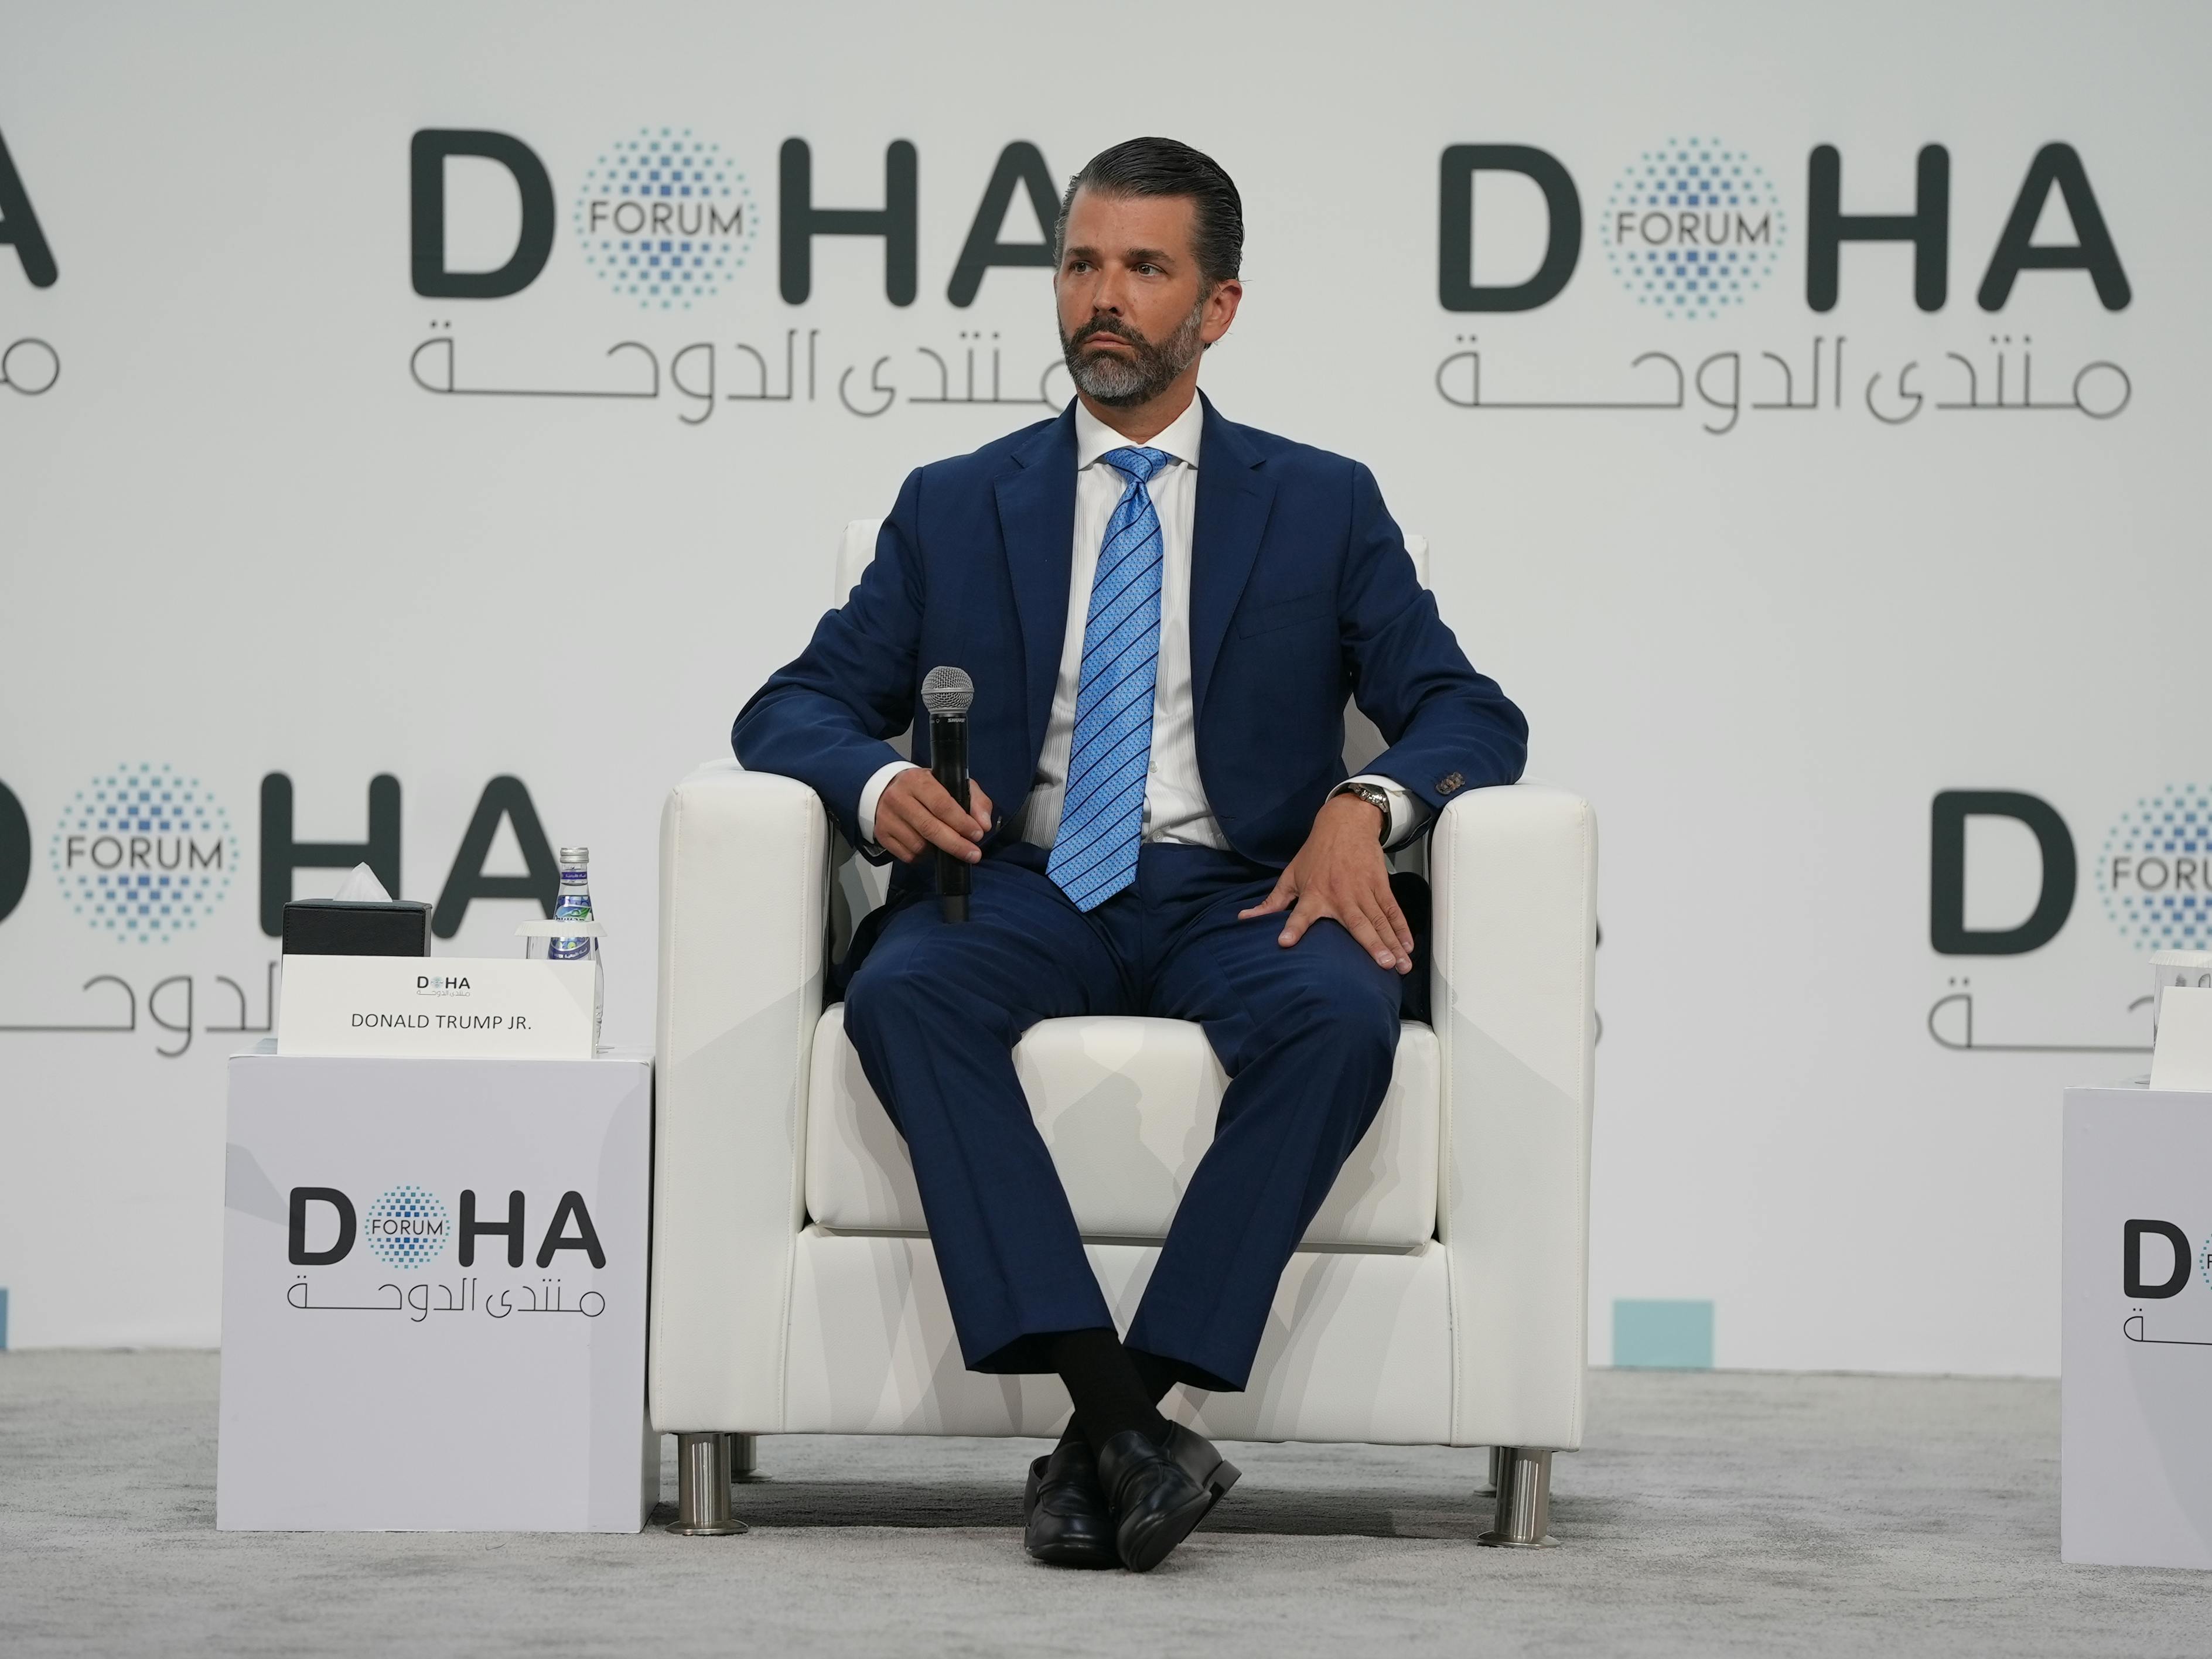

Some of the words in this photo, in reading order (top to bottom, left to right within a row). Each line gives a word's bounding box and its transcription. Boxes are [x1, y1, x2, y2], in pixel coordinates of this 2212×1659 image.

[590, 200, 743, 236] FORUM
[1617, 211, 1770, 245] FORUM
[409, 320, 819, 426] الدوحة
[1435, 334, 1846, 436] الدوحة
[1865, 334, 2132, 425] منتدى
[66, 836, 223, 871] FORUM
[351, 1013, 429, 1028] DONALD
[436, 1015, 503, 1029] TRUMP
[507, 1016, 531, 1030] JR.
[372, 1219, 443, 1235] FORUM
[287, 1275, 477, 1322] الدوحة
[486, 1279, 606, 1319] منتدى
